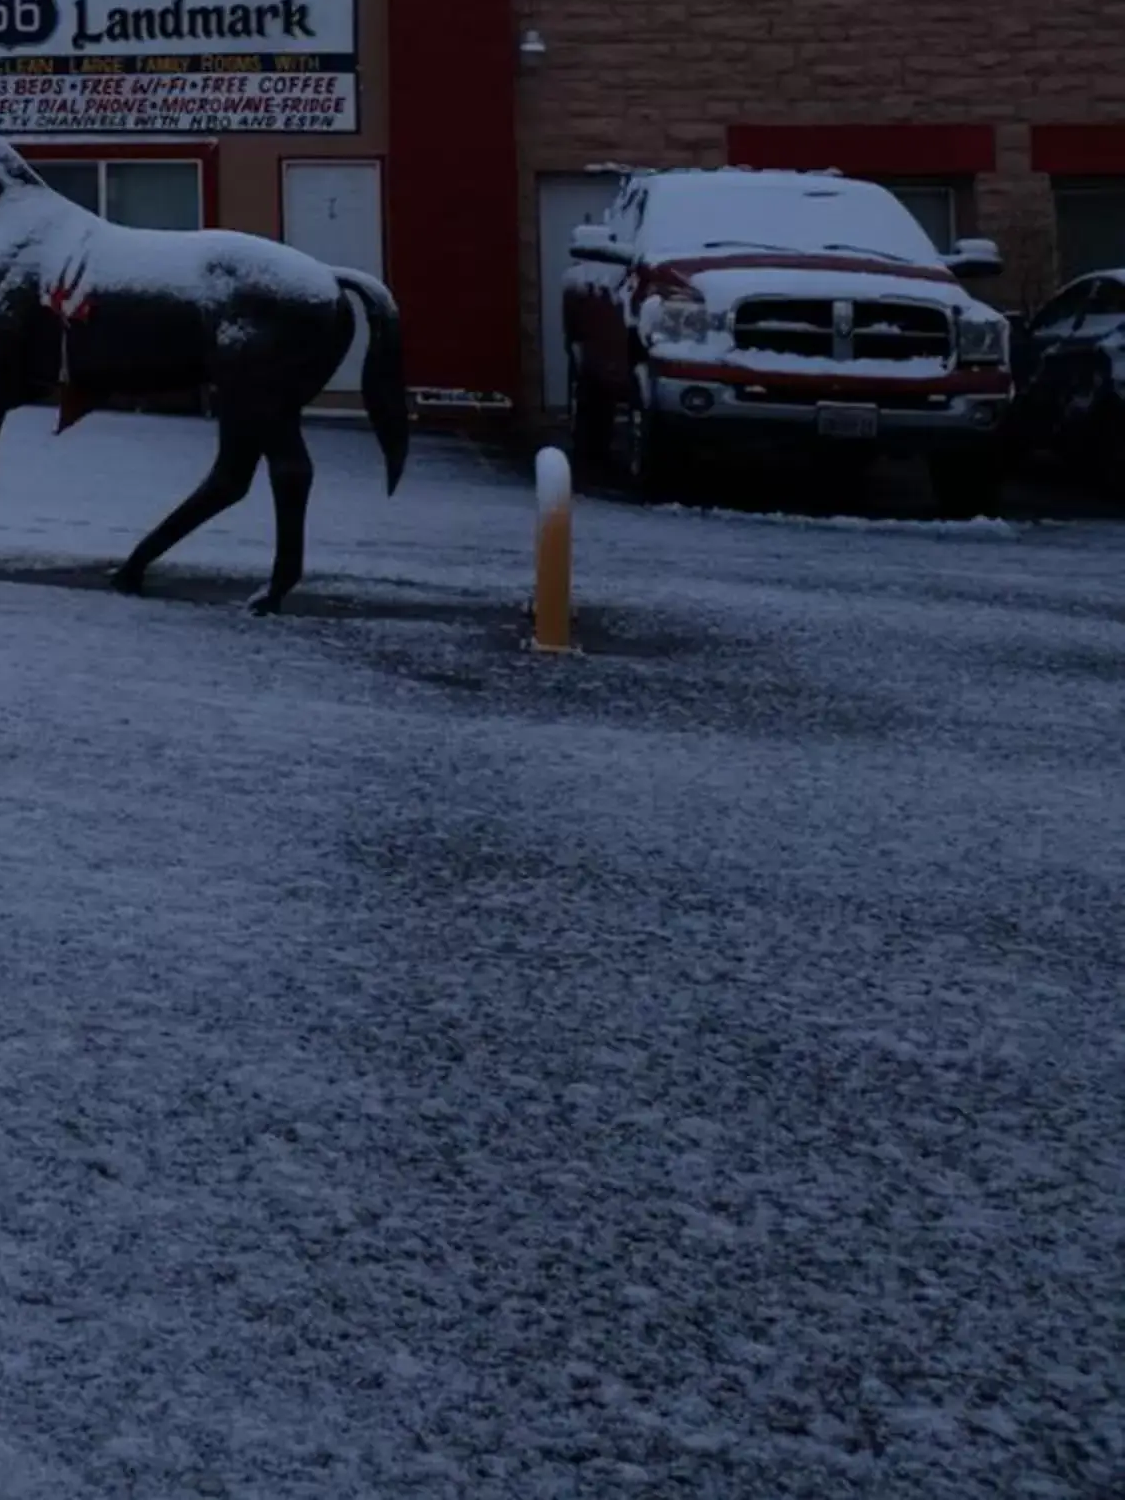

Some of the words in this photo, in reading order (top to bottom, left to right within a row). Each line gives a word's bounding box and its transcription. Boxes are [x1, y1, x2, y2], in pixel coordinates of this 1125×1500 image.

[274, 56, 320, 73] WITH
[13, 78, 66, 96] BEDS
[79, 78, 126, 96] FREE
[200, 76, 249, 94] FREE
[258, 76, 338, 94] COFFEE
[37, 98, 80, 115] DIAL
[84, 98, 150, 115] PHONE
[238, 115, 277, 127] AND
